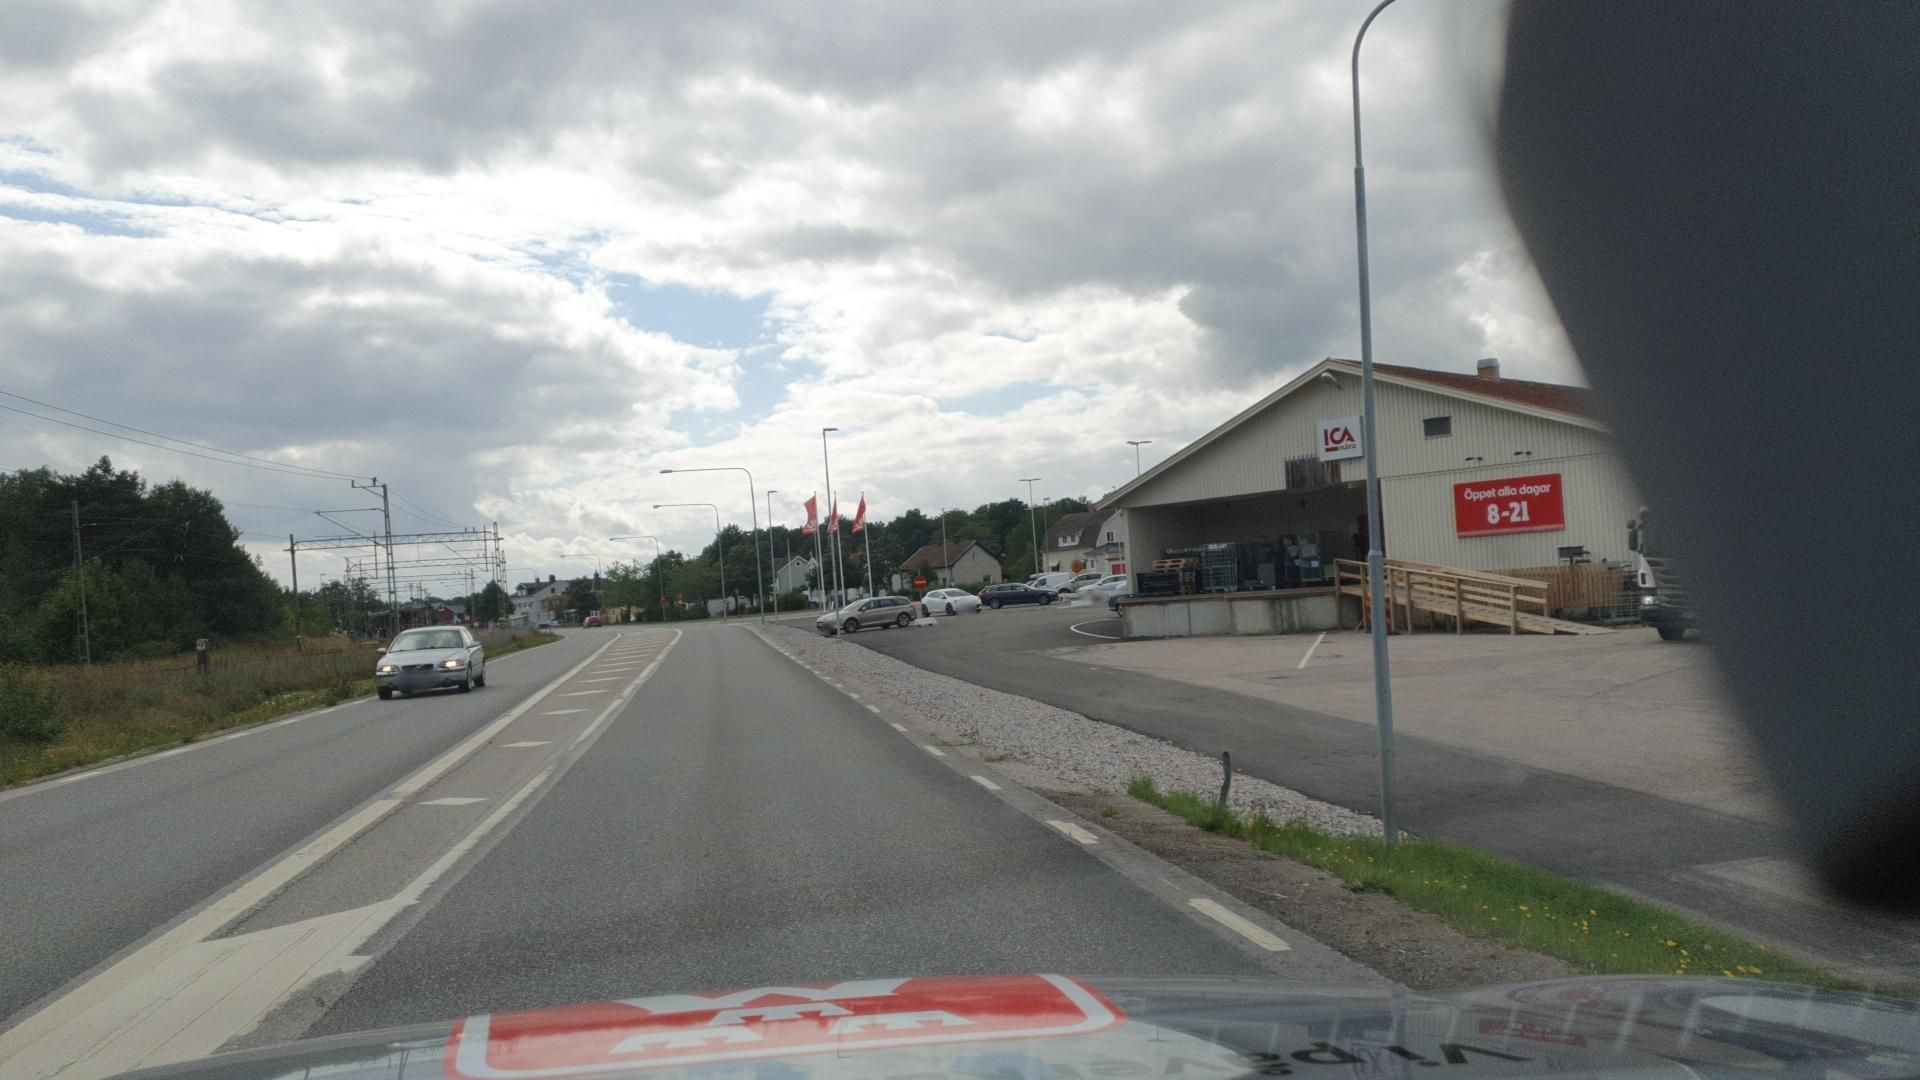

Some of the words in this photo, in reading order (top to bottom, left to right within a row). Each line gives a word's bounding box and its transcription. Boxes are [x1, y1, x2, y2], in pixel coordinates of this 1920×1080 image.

[1323, 426, 1355, 446] ICA
[1464, 488, 1496, 502] Öppet
[1498, 486, 1517, 497] alla
[1519, 484, 1551, 496] dagar
[1487, 501, 1530, 525] 8-21
